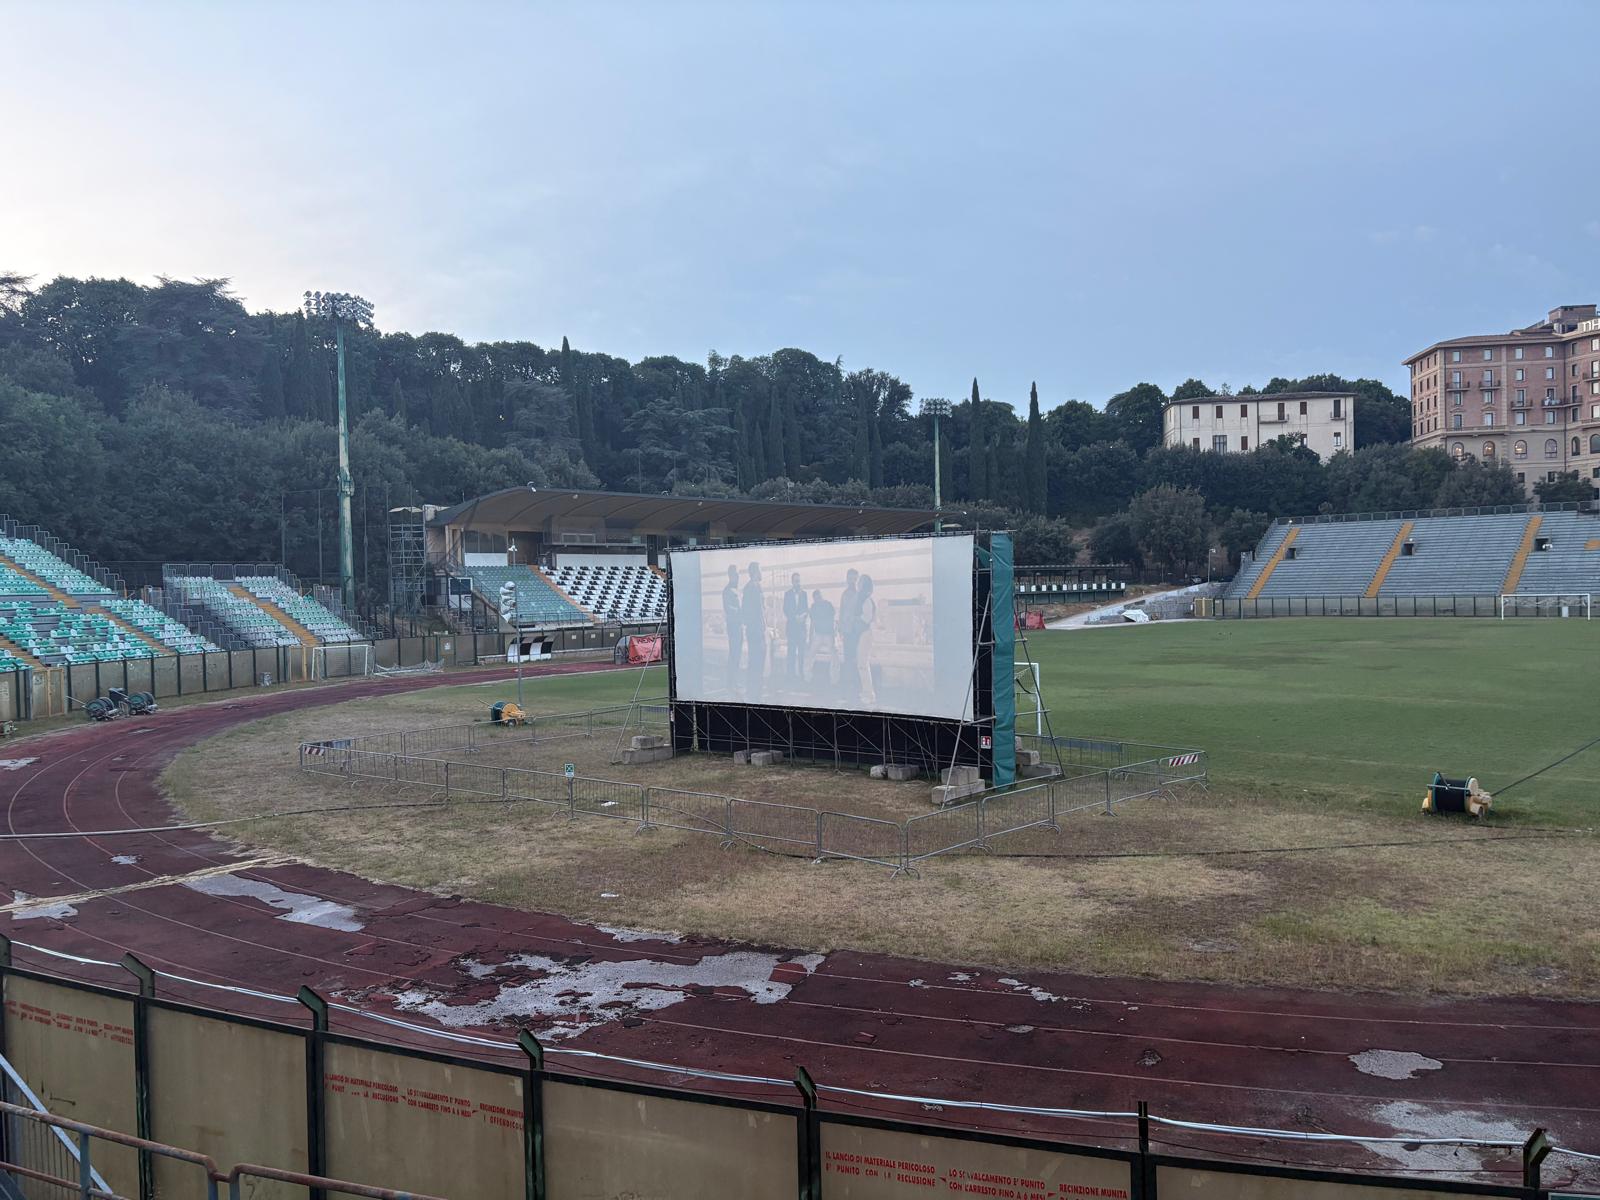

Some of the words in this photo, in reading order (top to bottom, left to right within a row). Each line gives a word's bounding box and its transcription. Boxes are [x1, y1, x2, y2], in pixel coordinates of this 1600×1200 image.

[833, 1152, 854, 1162] LANCIO
[855, 1155, 863, 1164] DI
[864, 1156, 896, 1168] MATERIALE
[898, 1161, 935, 1174] PERICOLOSO
[837, 1165, 860, 1175] PUNITO
[897, 1173, 936, 1187] RECLUSIONE
[949, 1169, 957, 1177] LO
[1021, 1179, 1045, 1190] PUNITO
[949, 1181, 962, 1190] CON
[965, 1183, 997, 1196] L'ARRESTO
[999, 1189, 1014, 1198] FINO
[1059, 1183, 1100, 1196] RECINZIONE
[1100, 1187, 1128, 1199] MUNITA
